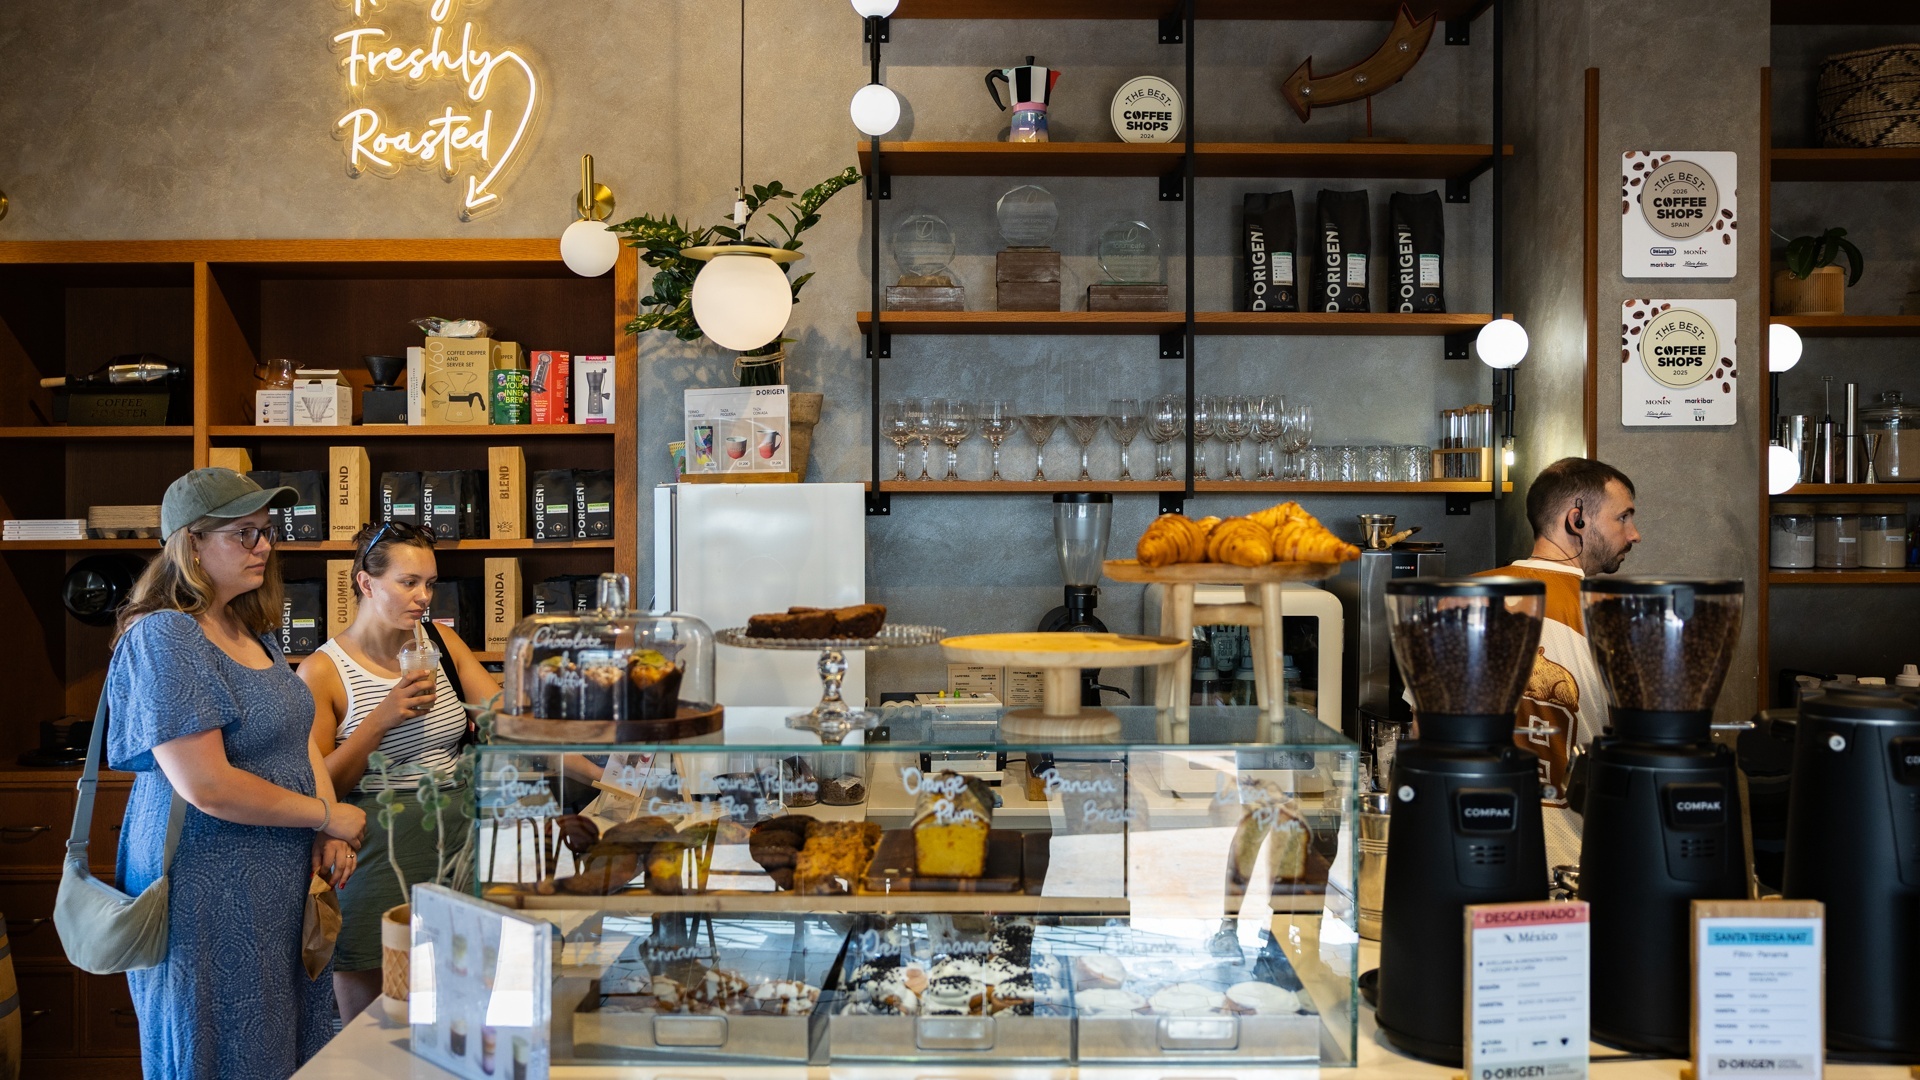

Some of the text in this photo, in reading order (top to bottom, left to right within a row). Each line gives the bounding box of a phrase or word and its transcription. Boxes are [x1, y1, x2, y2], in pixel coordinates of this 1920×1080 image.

[334, 22, 492, 101] Freshly
[1125, 88, 1172, 105] THE BEST
[1123, 110, 1173, 121] COFFEE
[1126, 121, 1169, 131] SHOPS
[338, 106, 493, 171] Roasted
[1654, 172, 1706, 190] THE BEST
[1653, 197, 1707, 207] COFFEE
[1656, 208, 1703, 219] SHOPS
[1655, 321, 1705, 339] THE BEST
[1654, 345, 1706, 356] COFFEE
[428, 341, 444, 375] V60
[1657, 357, 1703, 367] SHOPS
[506, 374, 522, 382] FIND
[96, 398, 143, 407] COFFEE
[505, 396, 523, 404] BREW
[91, 409, 147, 418] ROASTER
[339, 465, 349, 505] BLEND
[500, 465, 509, 500] BLEND
[338, 569, 348, 624] COLOMBIA
[495, 572, 504, 623] RUANDA
[532, 627, 603, 649] Chocolate
[901, 766, 968, 799] Orange
[1040, 768, 1116, 795] Banana
[933, 799, 979, 825] Plum
[1464, 808, 1511, 817] COMPAK
[1676, 801, 1721, 811] COMPAK
[1484, 908, 1576, 923] DESCAFEINADO
[1518, 930, 1558, 942] México
[1714, 932, 1746, 942] SANTA
[1749, 932, 1784, 942] TERESA
